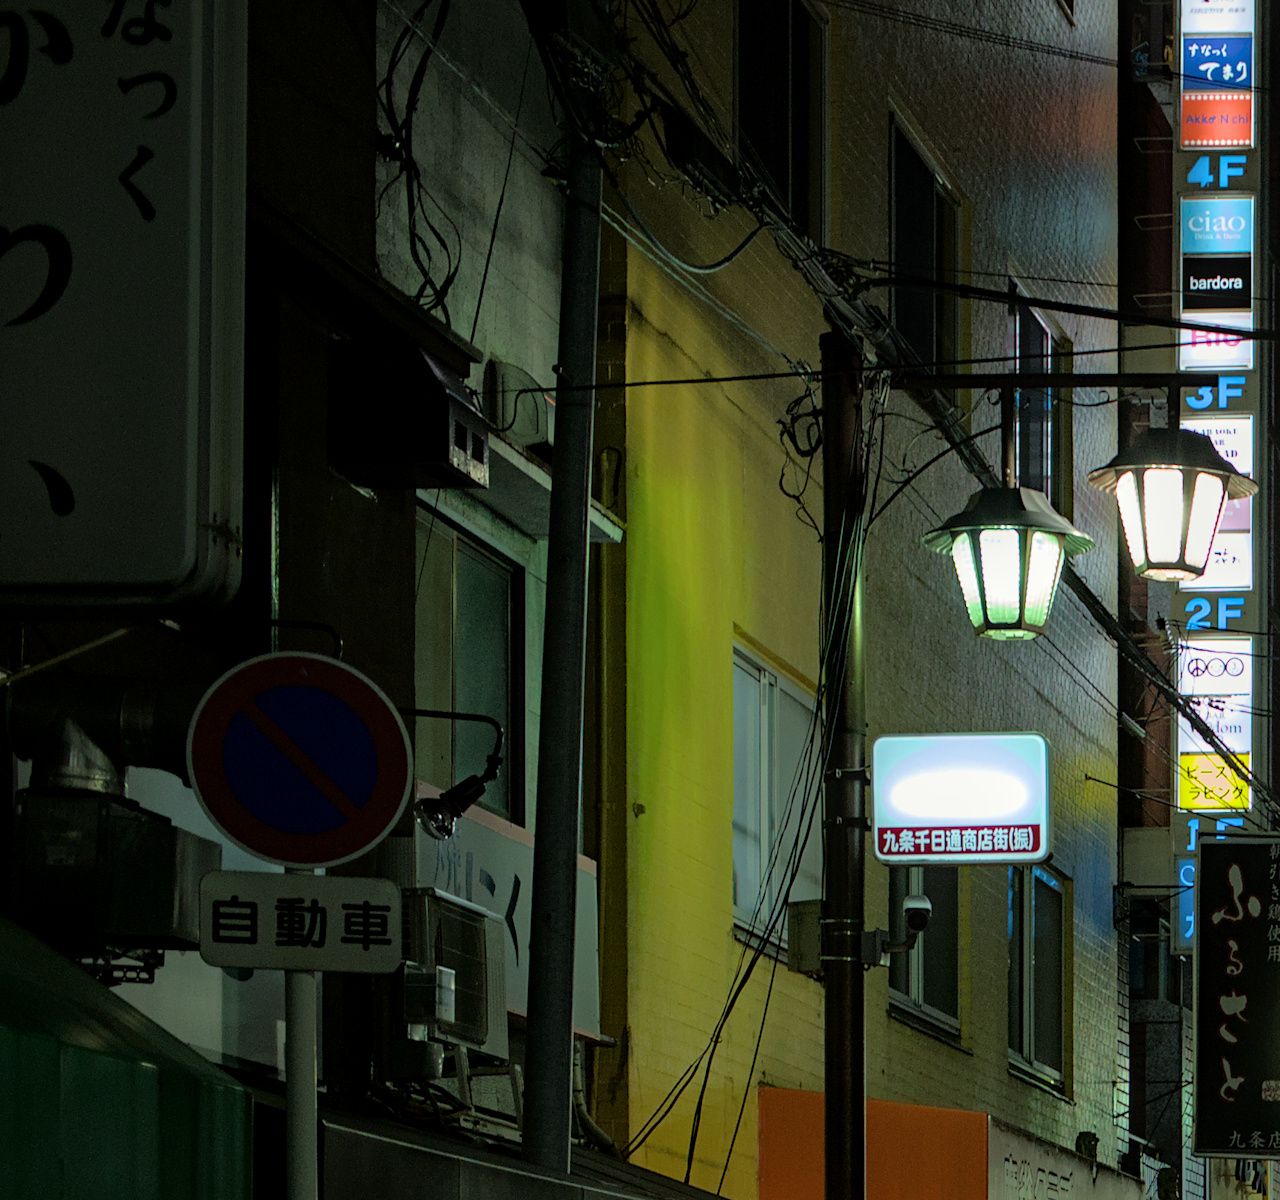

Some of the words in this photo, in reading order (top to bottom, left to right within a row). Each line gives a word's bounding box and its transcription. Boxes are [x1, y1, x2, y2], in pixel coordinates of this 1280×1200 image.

[1198, 61, 1247, 82] てまり
[1187, 155, 1247, 188] 4F
[1188, 210, 1246, 232] ciao
[1189, 275, 1243, 290] bardora
[1185, 376, 1247, 409] 3F
[1184, 597, 1245, 632] 2F
[882, 826, 1034, 853] 九条千日通商店街(振)
[212, 895, 393, 951] 自動車
